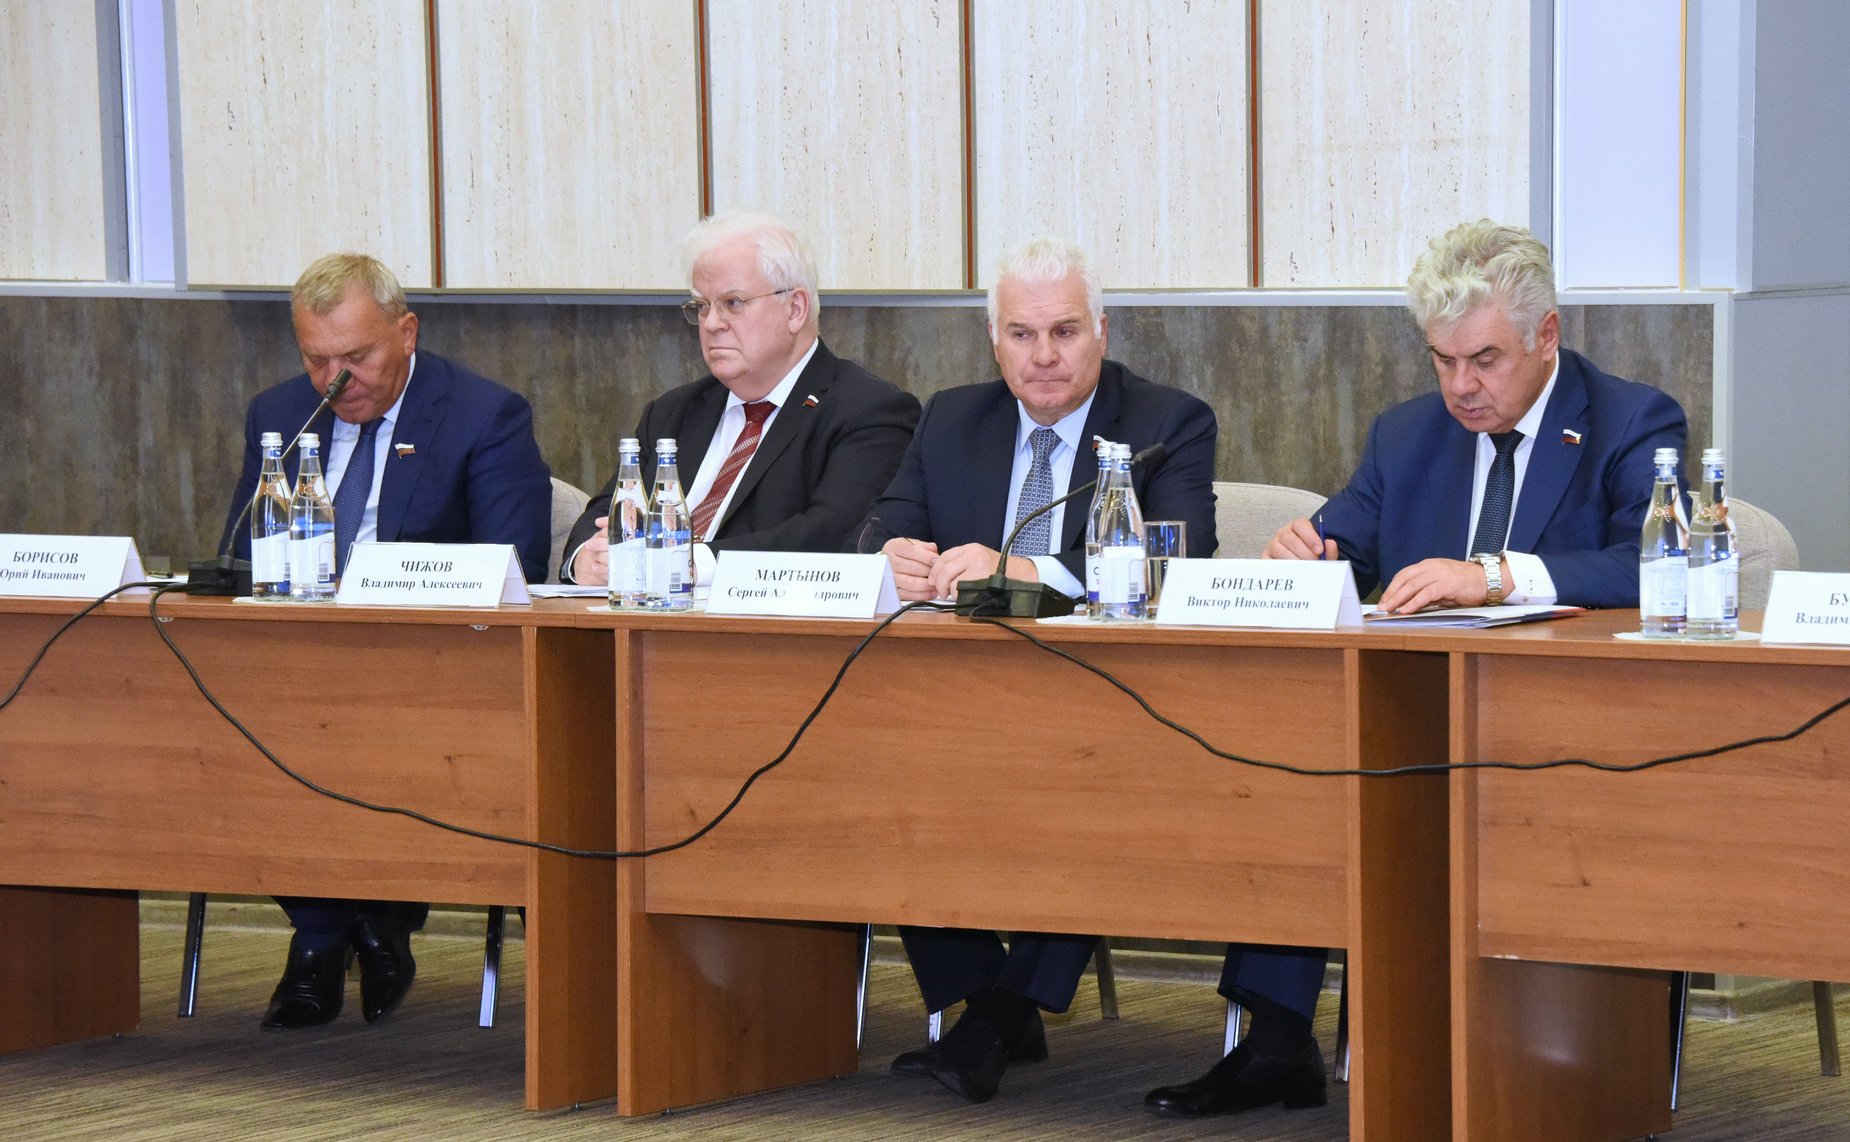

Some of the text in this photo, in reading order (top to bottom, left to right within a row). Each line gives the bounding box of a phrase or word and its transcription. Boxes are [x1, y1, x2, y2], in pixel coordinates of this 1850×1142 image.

[13, 551, 79, 564] БОРИСОВ
[401, 560, 453, 573] ЧИЖОВ
[31, 569, 86, 581] Иванович
[755, 569, 841, 583] МАРТЫНОВ
[360, 577, 483, 591] Владимир Алексеевич
[1211, 577, 1294, 592] БОНДАРЕВ
[727, 586, 768, 600] Сергей
[1187, 595, 1310, 610] Виктор Николаевич
